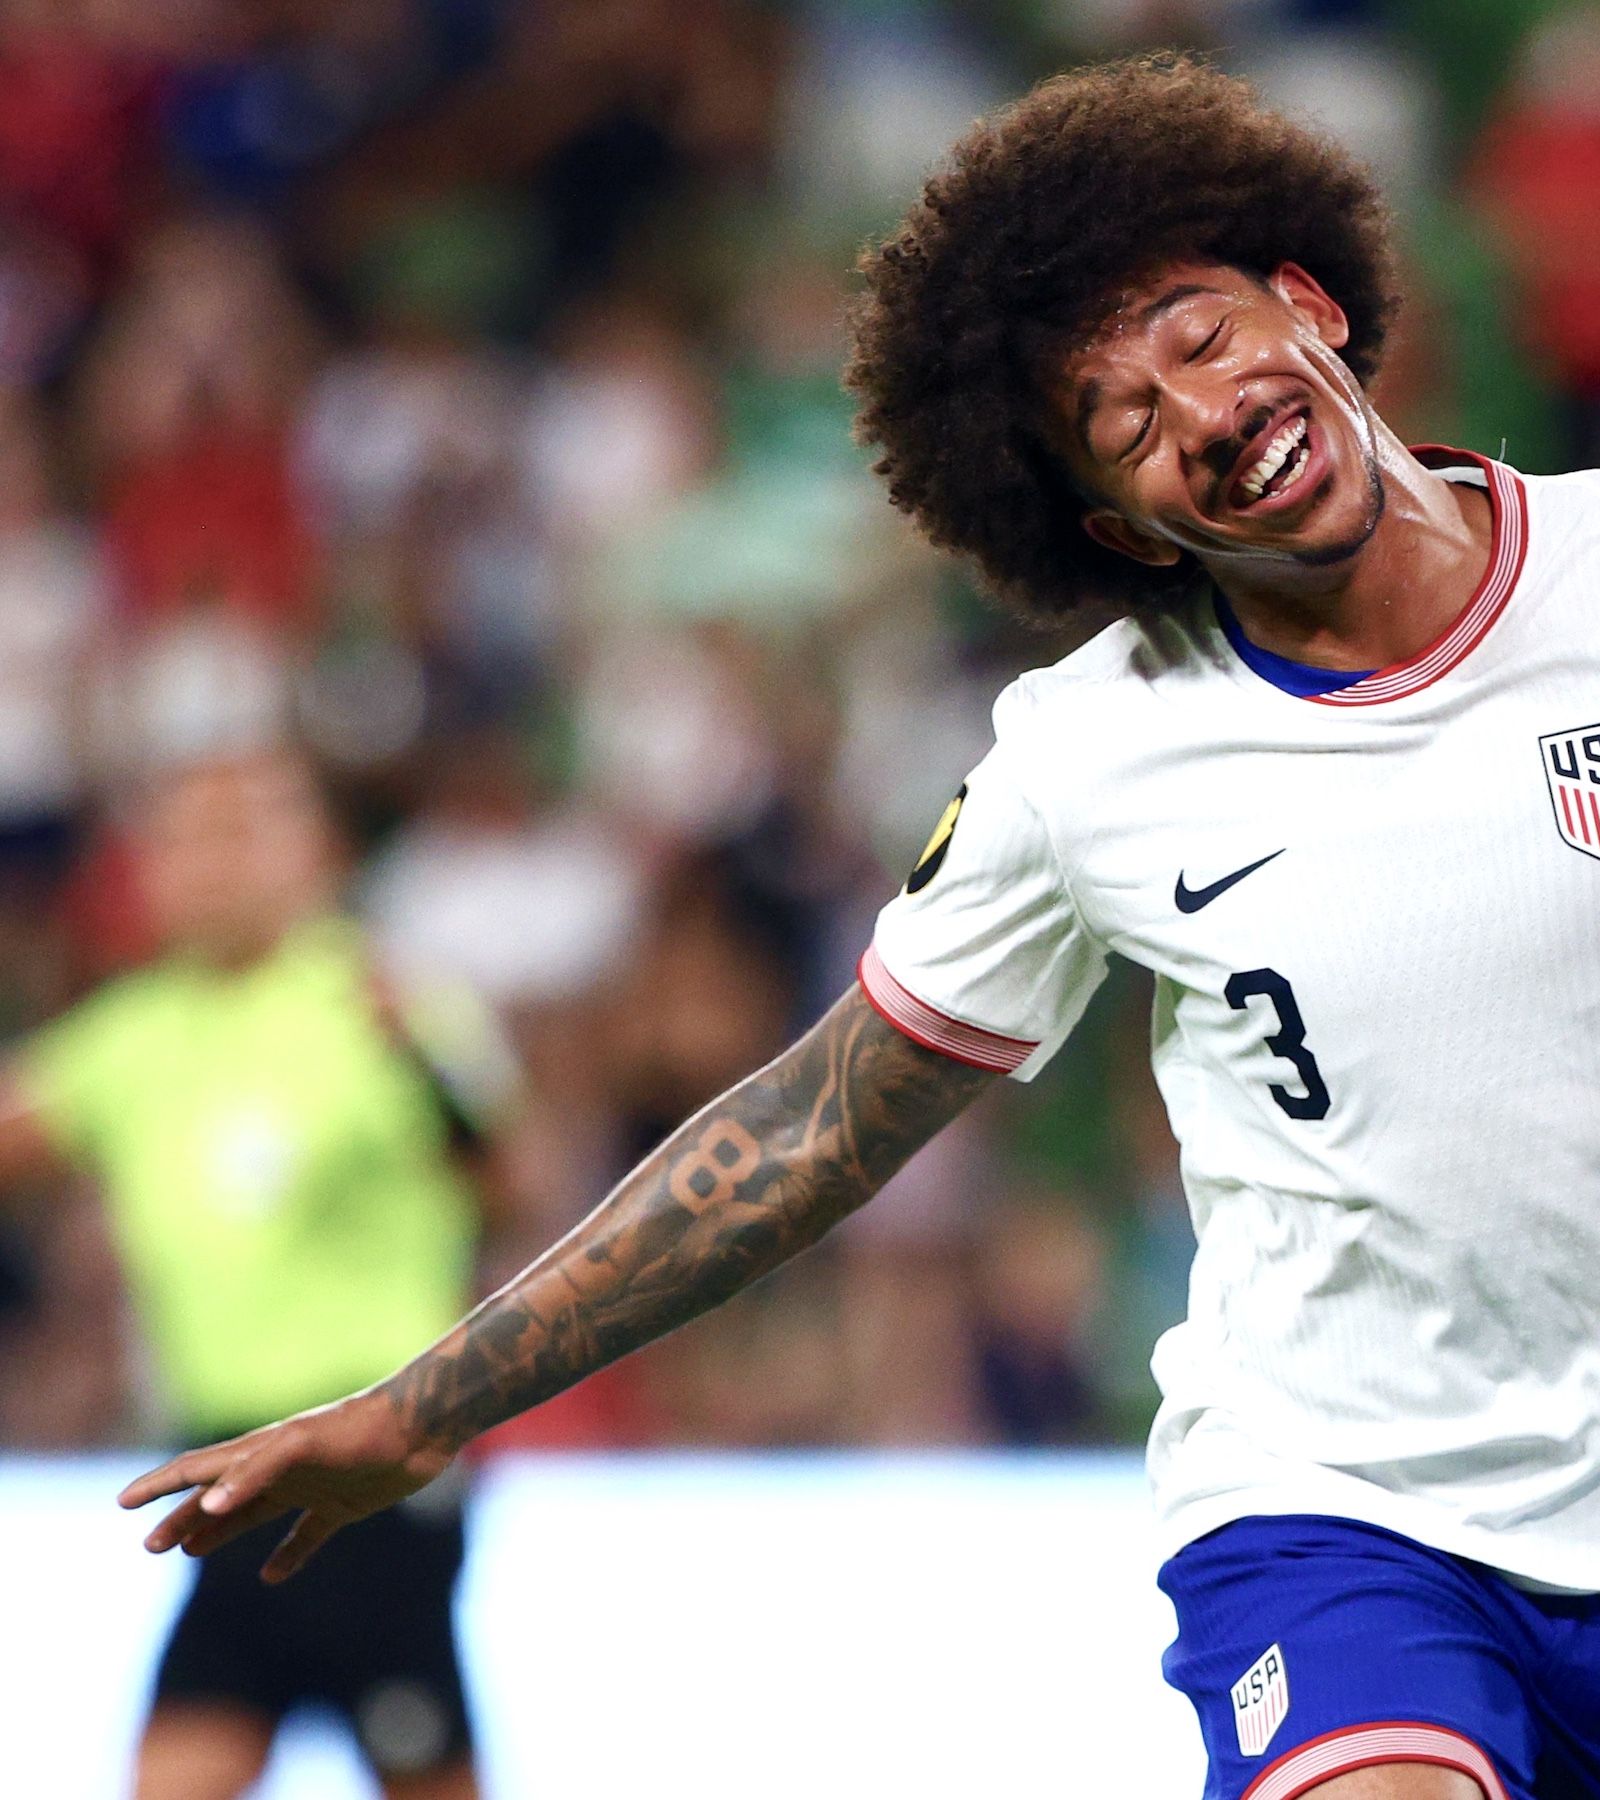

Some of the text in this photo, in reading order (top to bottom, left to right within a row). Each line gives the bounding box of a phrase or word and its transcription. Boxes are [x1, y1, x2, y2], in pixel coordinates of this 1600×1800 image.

[1224, 967, 1331, 1120] 3
[669, 1119, 761, 1216] 8
[1236, 1653, 1279, 1710] USA
